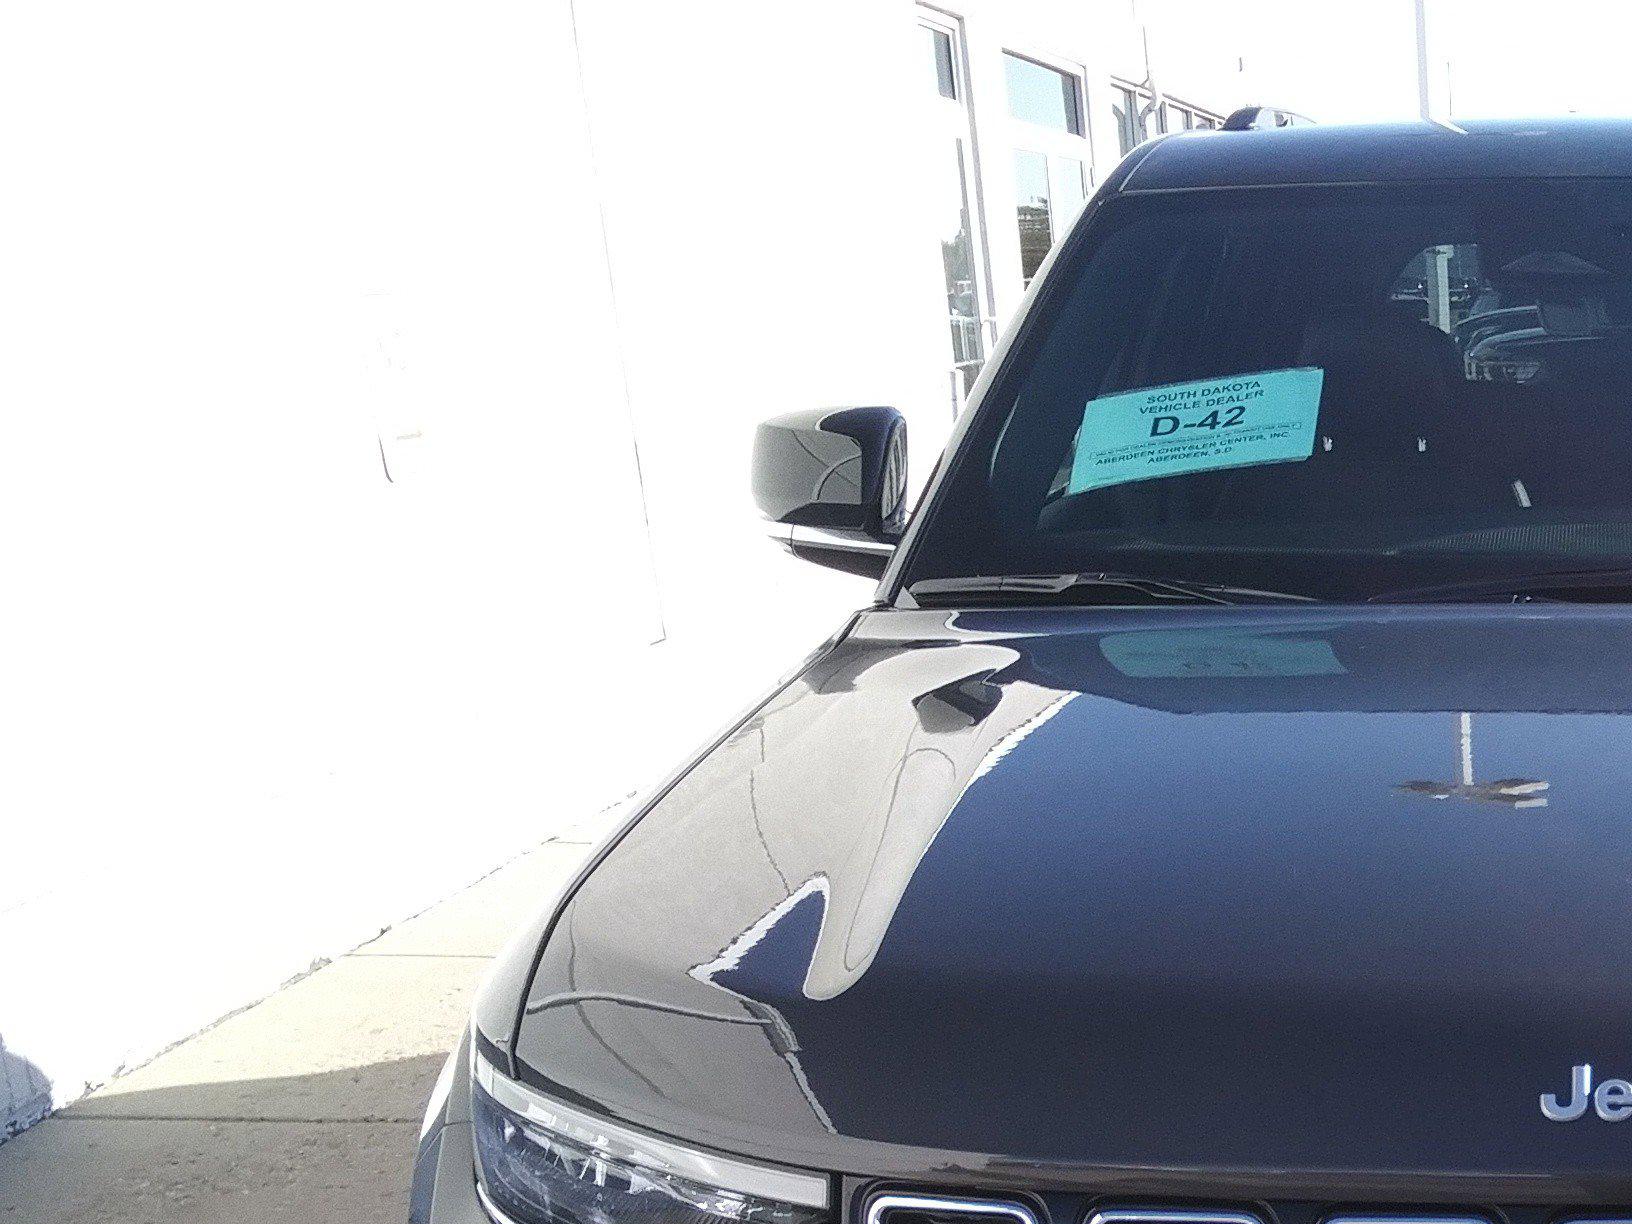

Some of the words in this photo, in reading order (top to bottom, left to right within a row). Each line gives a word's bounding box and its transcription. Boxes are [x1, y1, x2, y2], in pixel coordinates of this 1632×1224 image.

[1139, 400, 1201, 414] VEHICLE
[1205, 389, 1264, 407] DEALER
[1146, 390, 1198, 405] SOUTH
[1201, 381, 1261, 397] DAKOTA
[1149, 405, 1246, 438] D-42
[1095, 449, 1156, 466] ABERDEEN
[1157, 441, 1217, 456] CHRYSLER
